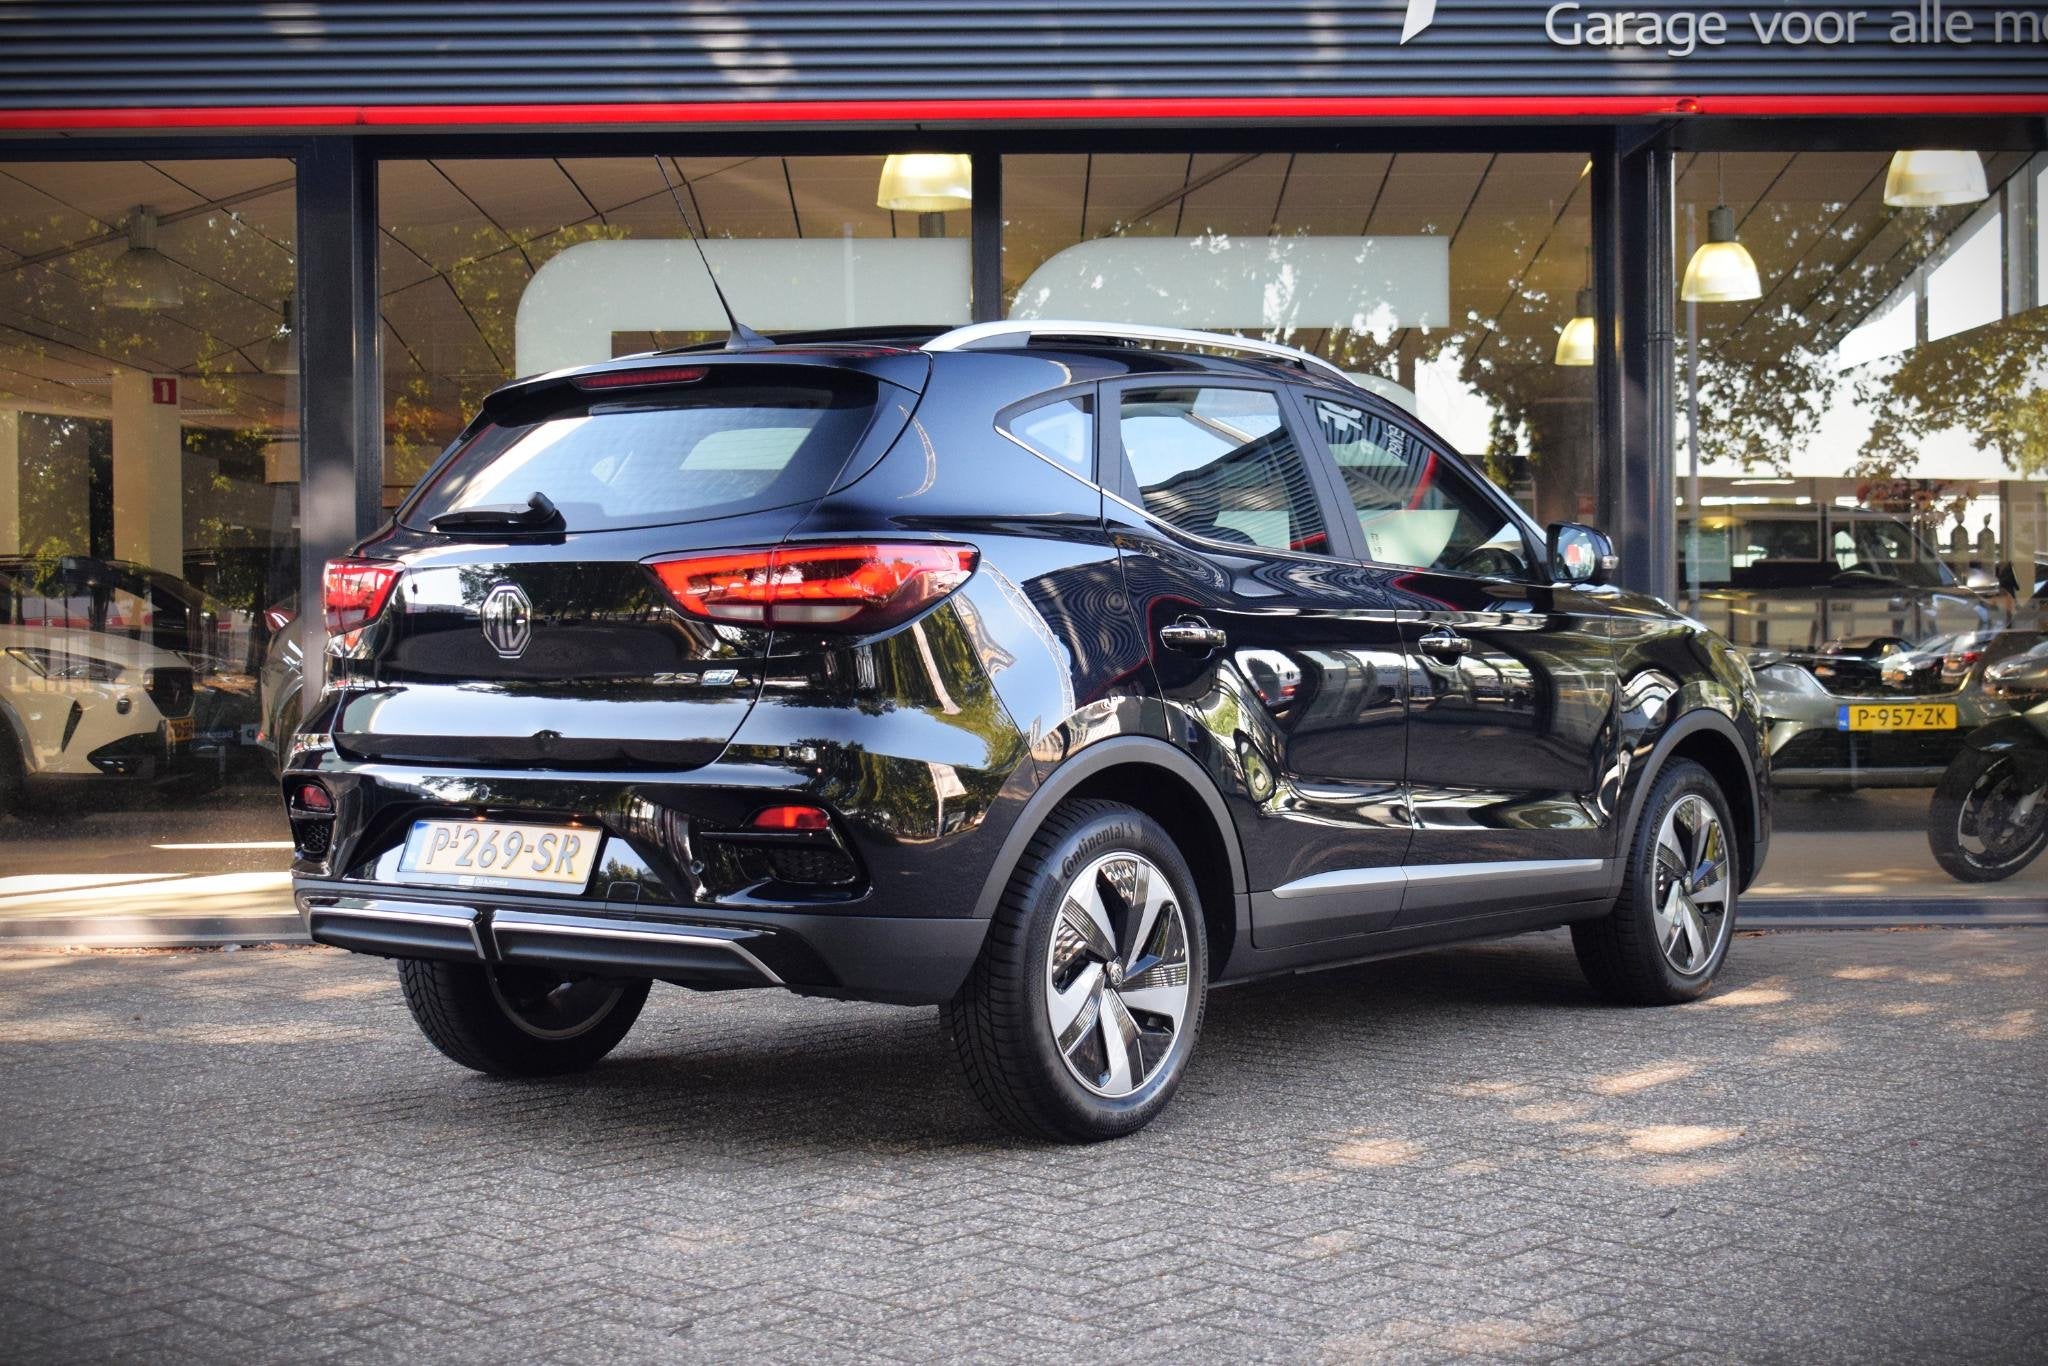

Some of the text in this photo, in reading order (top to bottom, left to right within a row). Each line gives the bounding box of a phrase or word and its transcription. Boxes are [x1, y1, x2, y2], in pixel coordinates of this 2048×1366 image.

[1545, 0, 2048, 57] Garage voor alle m
[483, 586, 531, 654] MG
[653, 672, 699, 685] ZS
[1857, 707, 1949, 727] P-957-ZK
[425, 824, 582, 874] P-269-SR
[1061, 821, 1125, 879] Continental
